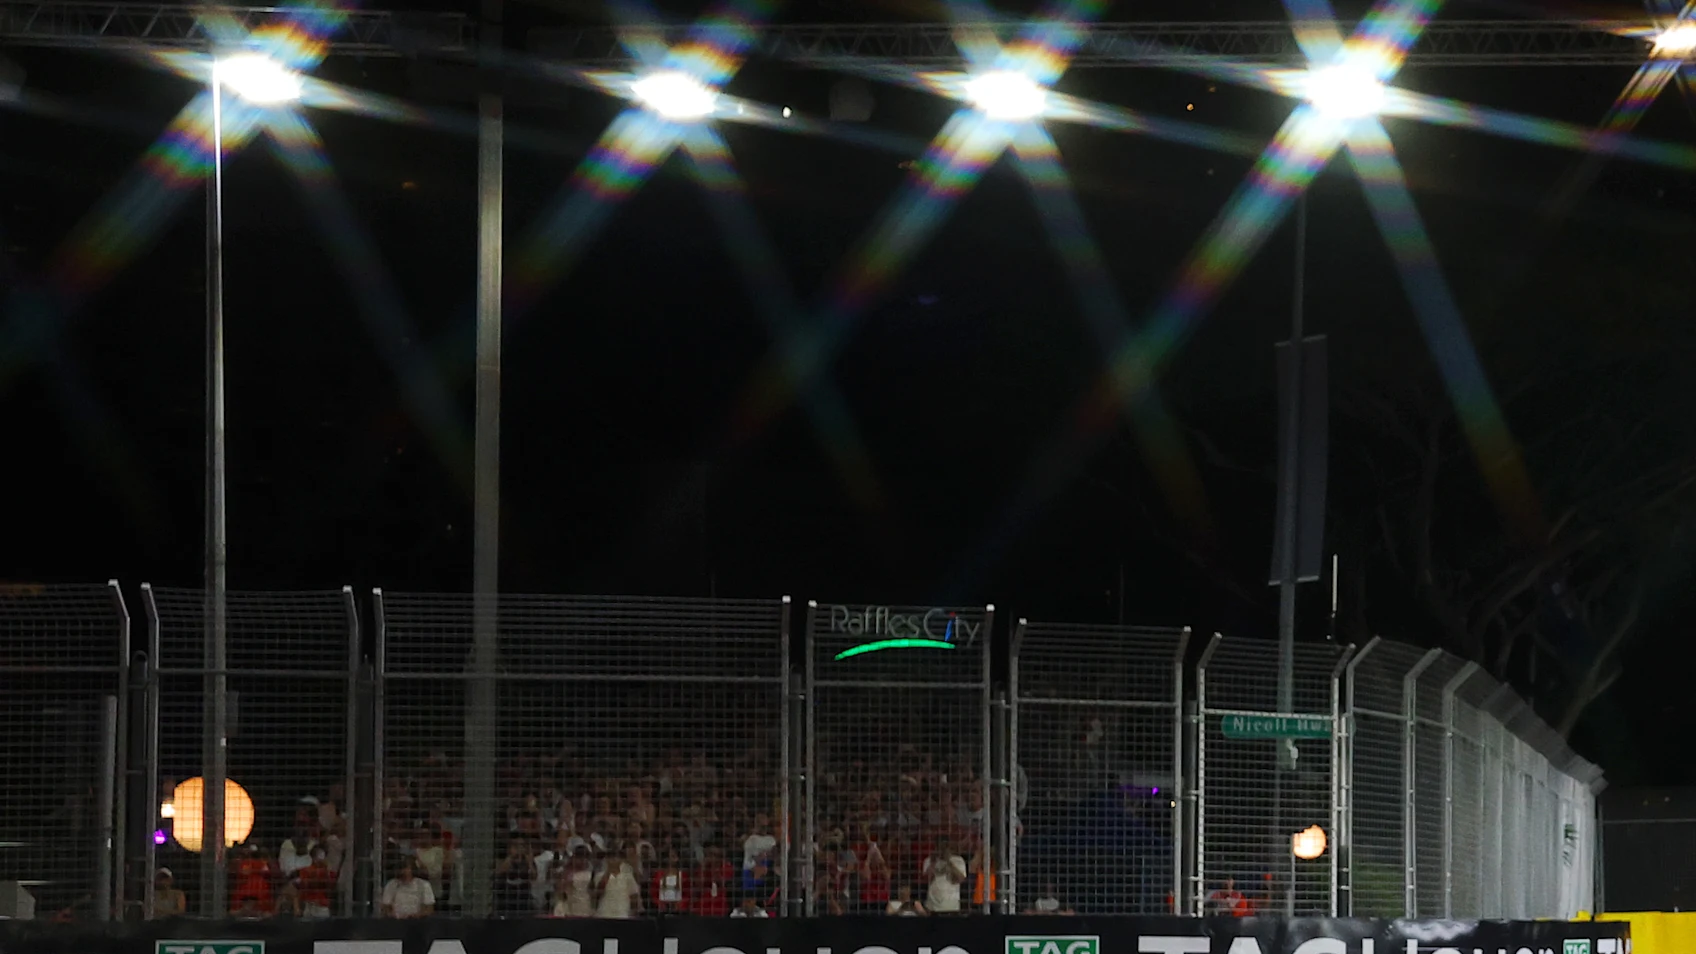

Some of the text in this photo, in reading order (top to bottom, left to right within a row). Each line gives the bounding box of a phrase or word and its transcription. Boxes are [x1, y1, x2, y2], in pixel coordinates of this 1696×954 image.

[830, 604, 980, 647] Raffles City
[1233, 716, 1287, 731] Nicoll
